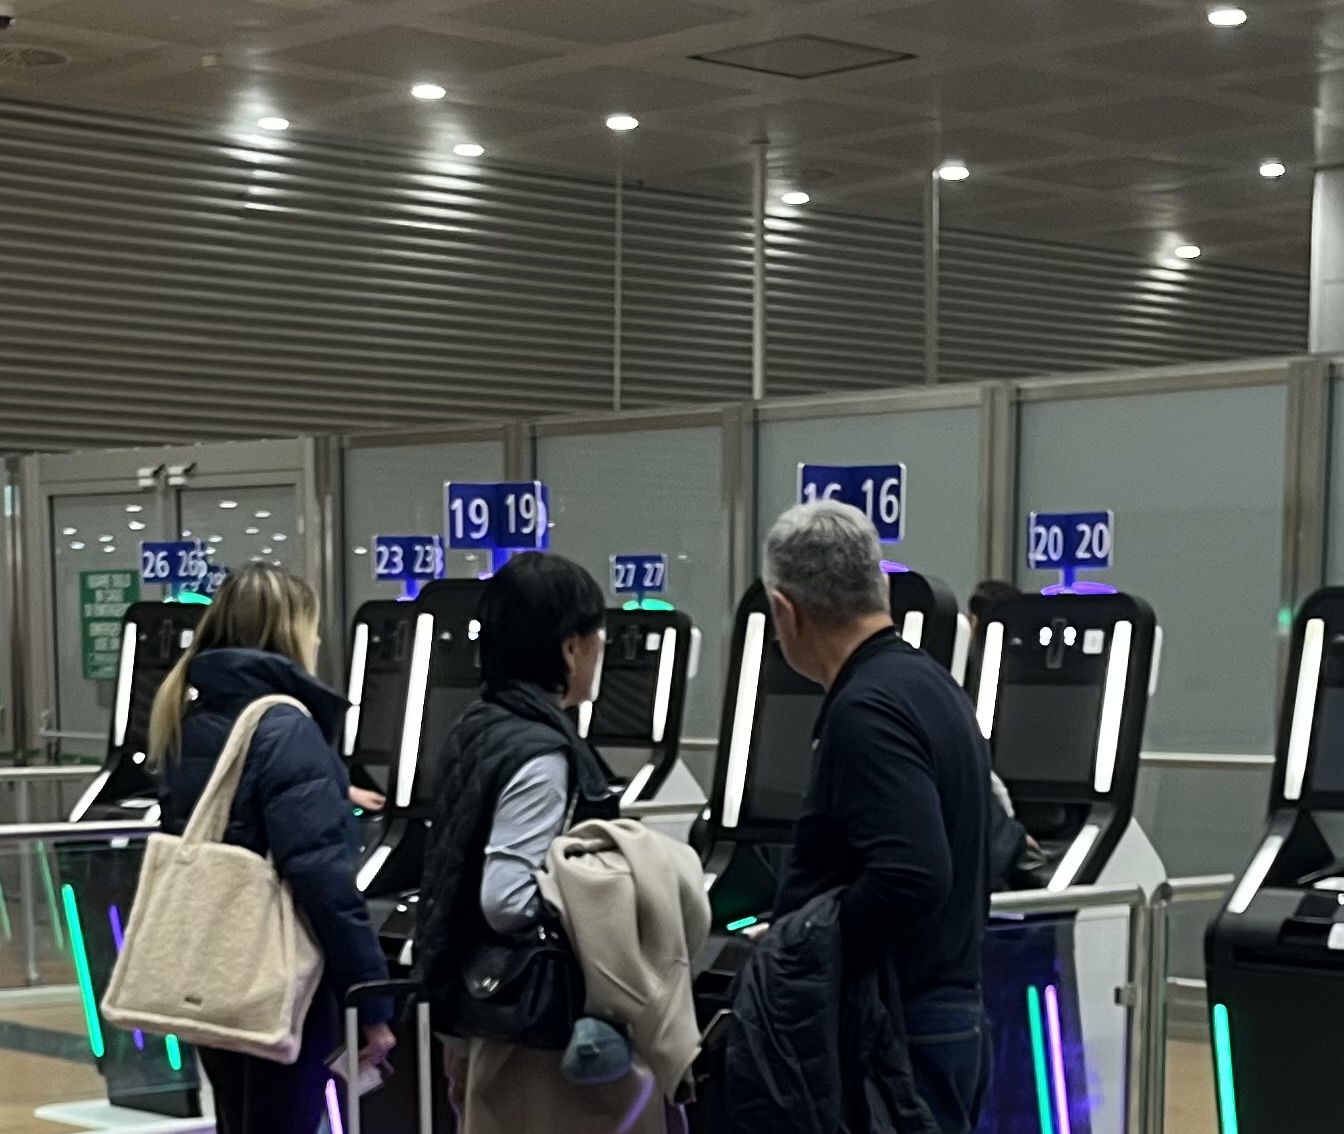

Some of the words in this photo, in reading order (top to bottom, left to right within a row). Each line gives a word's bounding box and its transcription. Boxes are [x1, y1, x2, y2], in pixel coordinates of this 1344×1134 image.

[451, 498, 489, 539] 19
[506, 493, 536, 534] 19
[861, 478, 899, 524] 16
[1033, 525, 1064, 561] 20
[1075, 523, 1111, 558] 20
[143, 551, 171, 578] 26
[376, 545, 404, 575] 23
[615, 564, 636, 588] 27
[643, 563, 664, 587] 27
